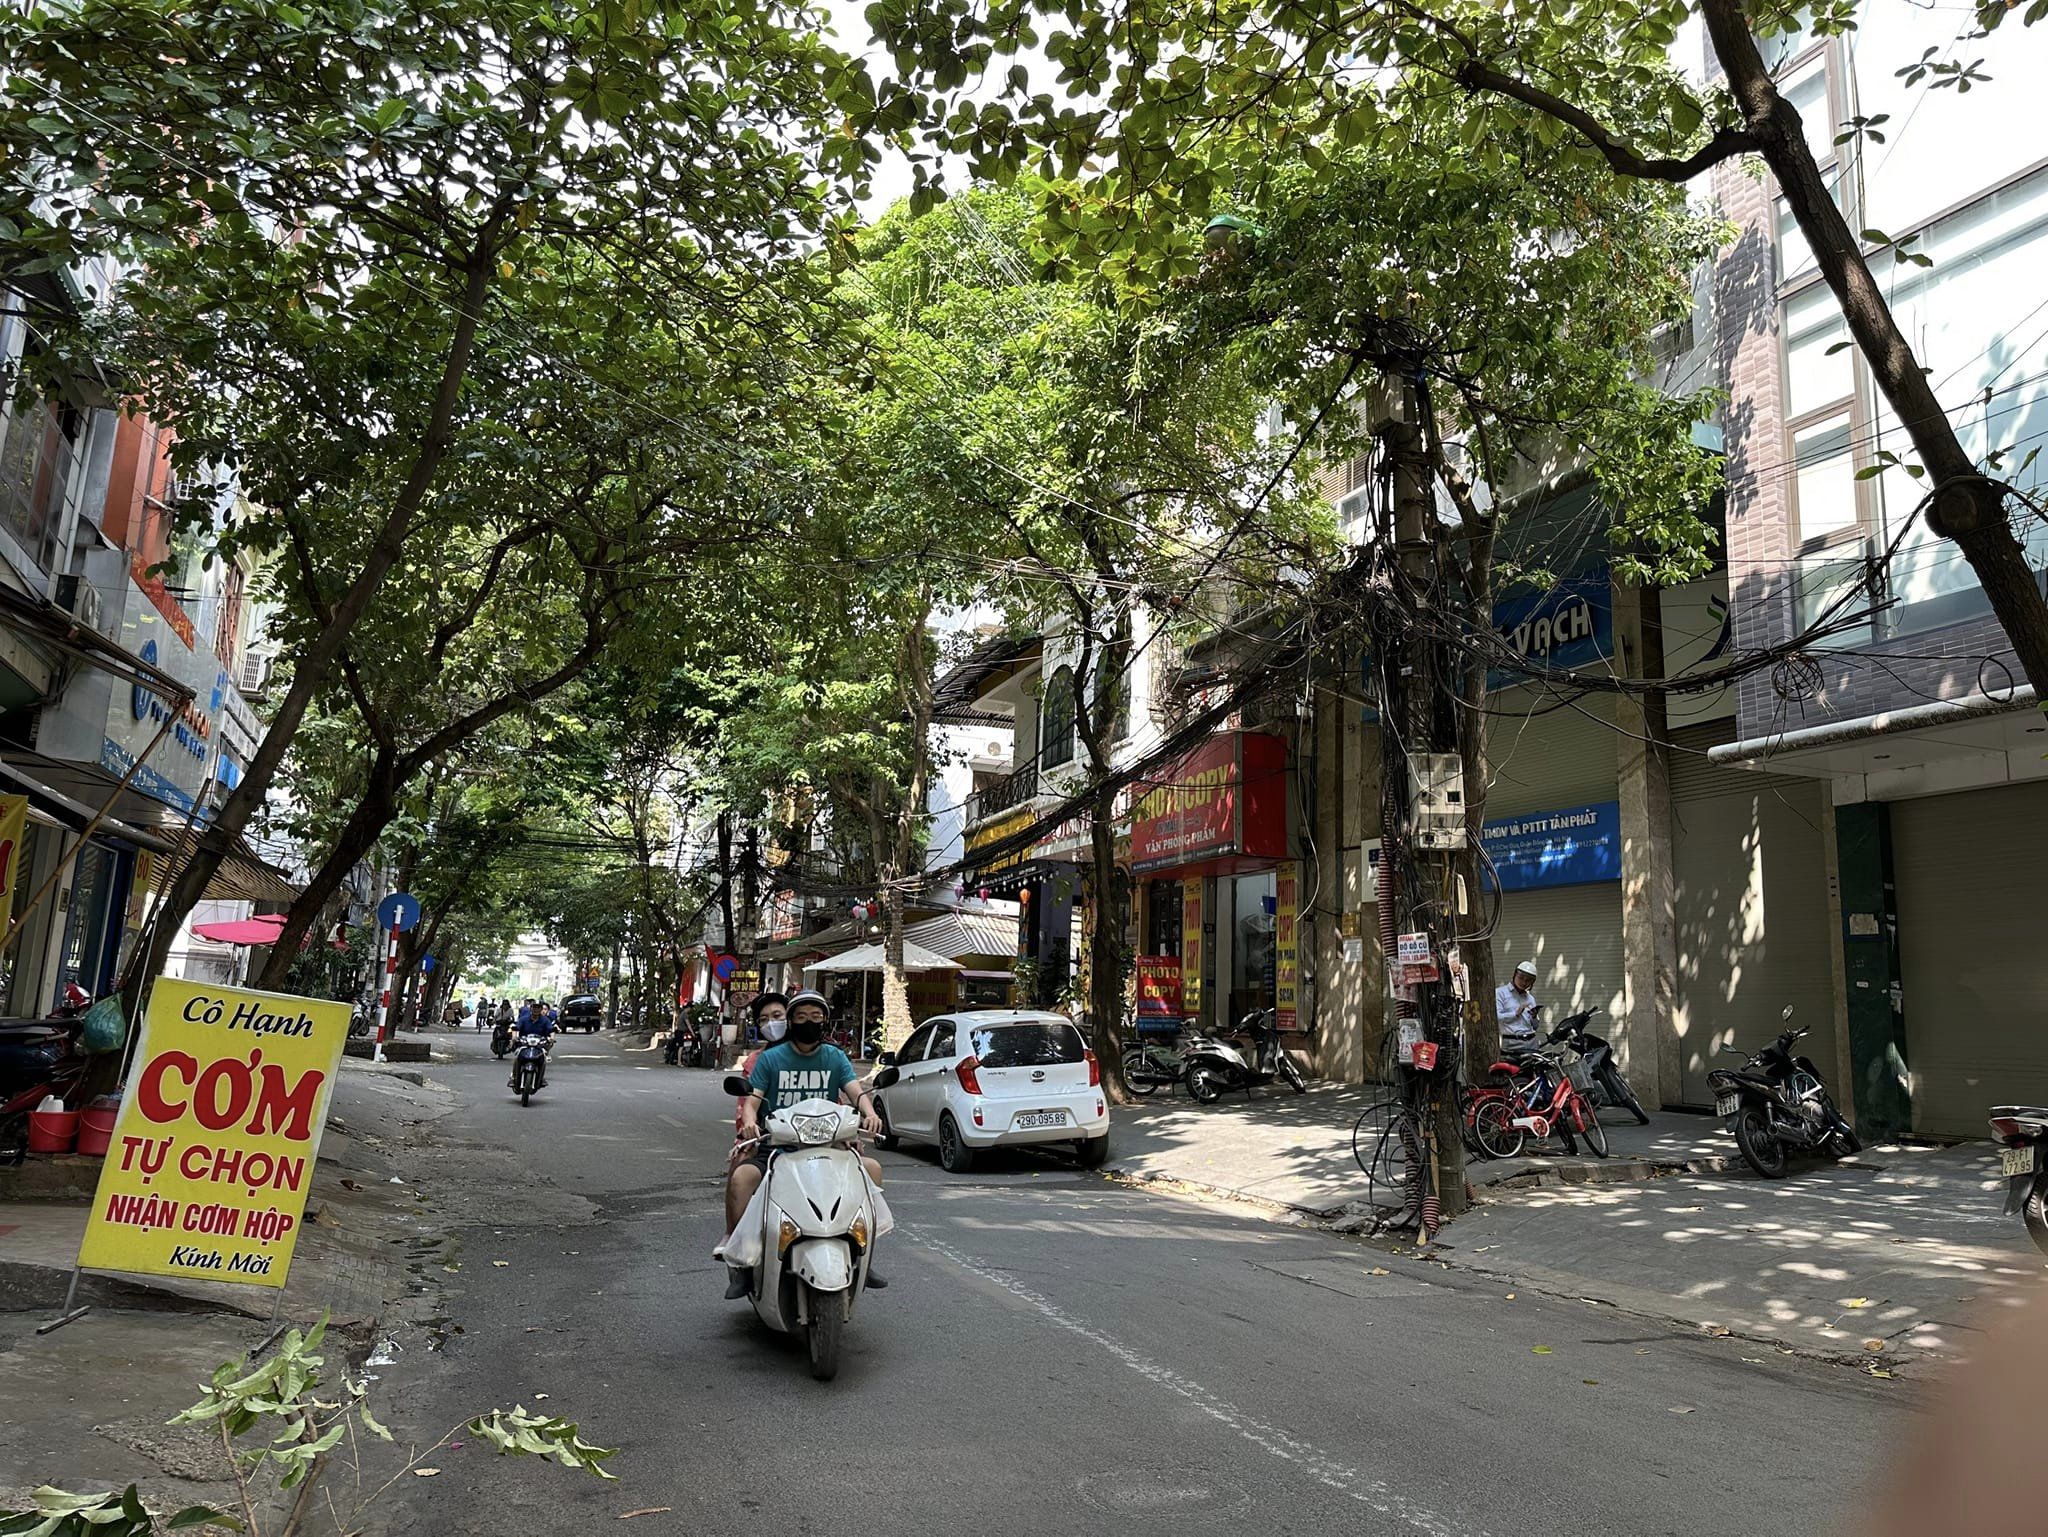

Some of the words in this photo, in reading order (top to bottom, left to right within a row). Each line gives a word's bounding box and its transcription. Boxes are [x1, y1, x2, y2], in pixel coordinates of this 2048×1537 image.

[1515, 603, 1590, 657] VẠCH
[1549, 814, 1570, 830] TÂN
[1570, 808, 1598, 827] PHÁT
[1145, 839, 1162, 854] VĂN
[1163, 833, 1191, 850] PHÒNG
[1191, 825, 1216, 845] PHẨM
[1139, 966, 1179, 979] PHOTO
[1144, 984, 1176, 998] COPY
[183, 996, 225, 1025] Cô
[228, 1002, 314, 1039] Hạnh
[137, 1047, 325, 1142] CƠM
[779, 1071, 832, 1089] READY
[777, 1092, 802, 1106] FOR
[120, 1136, 174, 1184] TỰ
[179, 1145, 306, 1197] CHỌN
[105, 1194, 179, 1233] NHẬN
[183, 1201, 239, 1237] CƠM
[243, 1209, 294, 1246] HỘP
[169, 1246, 222, 1269] Kính
[227, 1252, 274, 1275] Mời
